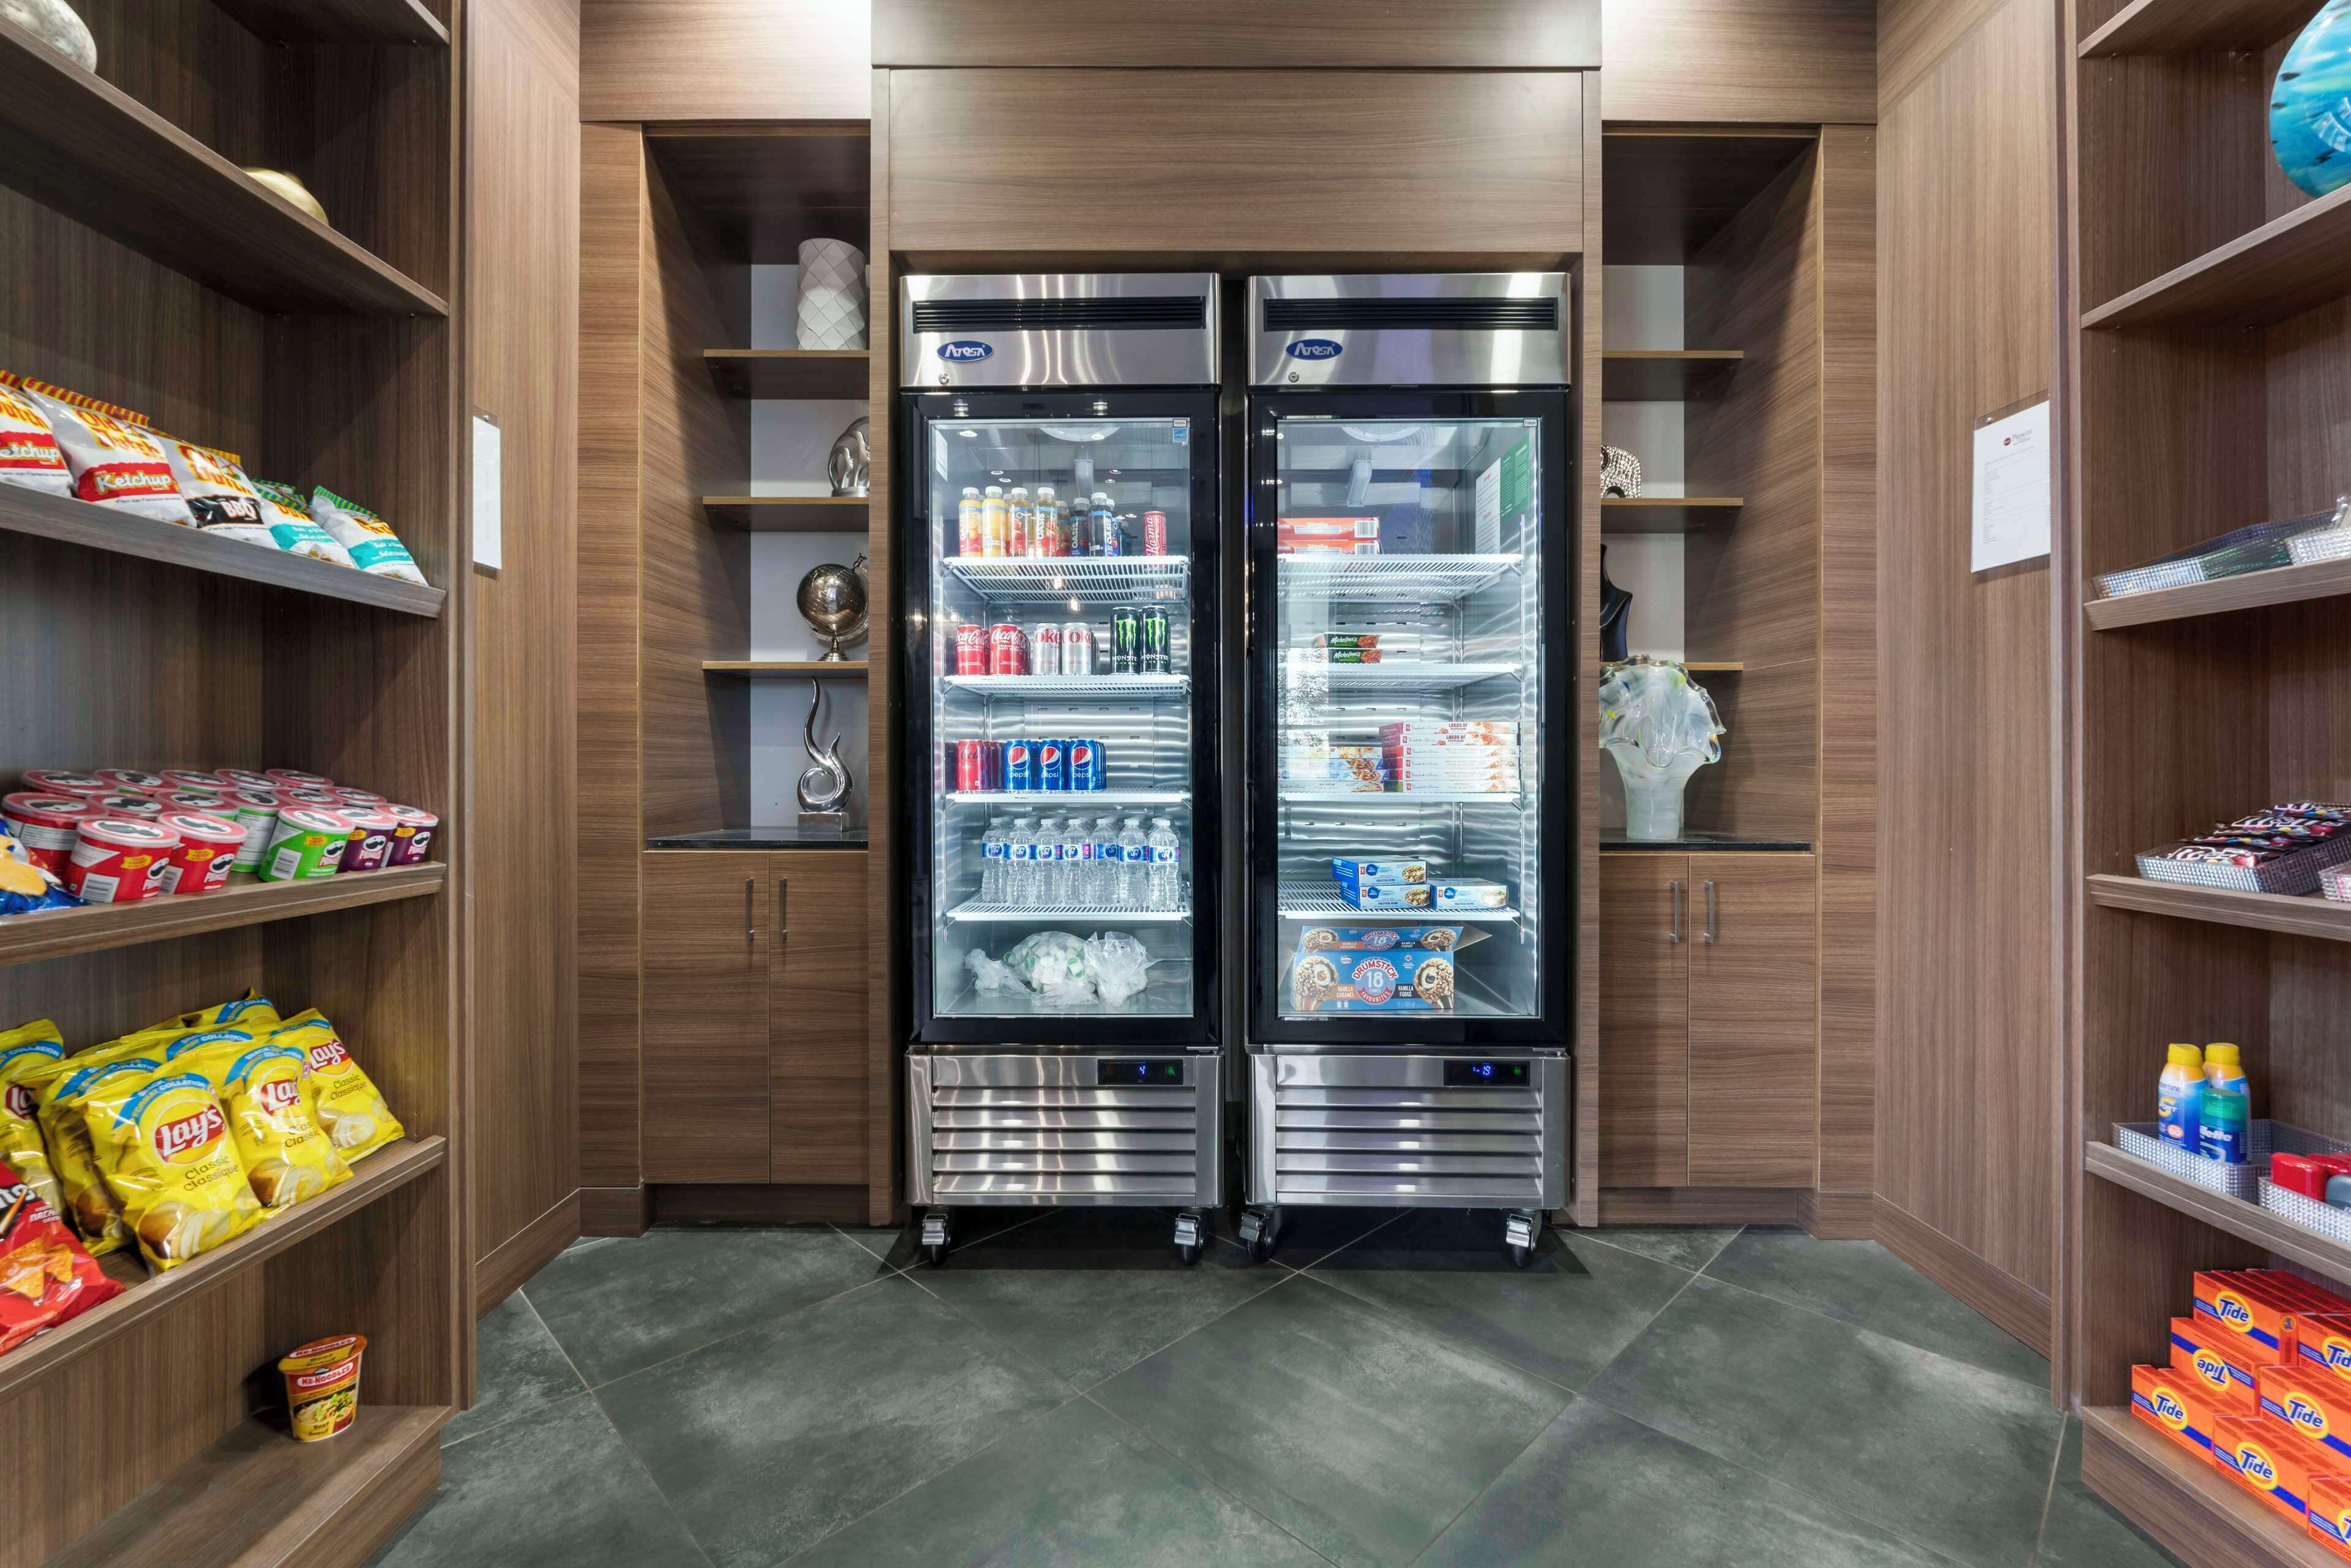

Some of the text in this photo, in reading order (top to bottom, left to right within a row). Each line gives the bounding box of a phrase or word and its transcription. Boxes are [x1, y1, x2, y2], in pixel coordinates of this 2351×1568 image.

[0, 442, 59, 465] etchup
[96, 469, 174, 495] Ketchup
[219, 499, 258, 520] BBQ
[1330, 636, 1358, 645] Michelina's
[1333, 651, 1361, 659] Michelina's
[1363, 931, 1400, 941] DRUMSTICK
[1352, 959, 1398, 980] DRUMSTICK
[1366, 971, 1384, 988] 18
[1360, 990, 1391, 1003] FAVOURITES
[9, 1046, 59, 1057] COLLATION
[310, 1040, 347, 1070] Lay's
[159, 1079, 208, 1090] COLLATION
[330, 1080, 368, 1101] Classique
[332, 1074, 362, 1090] Classic
[160, 1109, 223, 1157] Lay's
[183, 1165, 239, 1191] Classique
[184, 1155, 231, 1180] Classic
[2218, 1296, 2250, 1322] Tide
[2327, 1343, 2351, 1370] Tid
[315, 1365, 351, 1384] NOODLES
[2196, 1357, 2227, 1384] Tide
[2154, 1393, 2184, 1420] Tide
[2287, 1398, 2324, 1428] Tide
[2239, 1449, 2273, 1480] Tide
